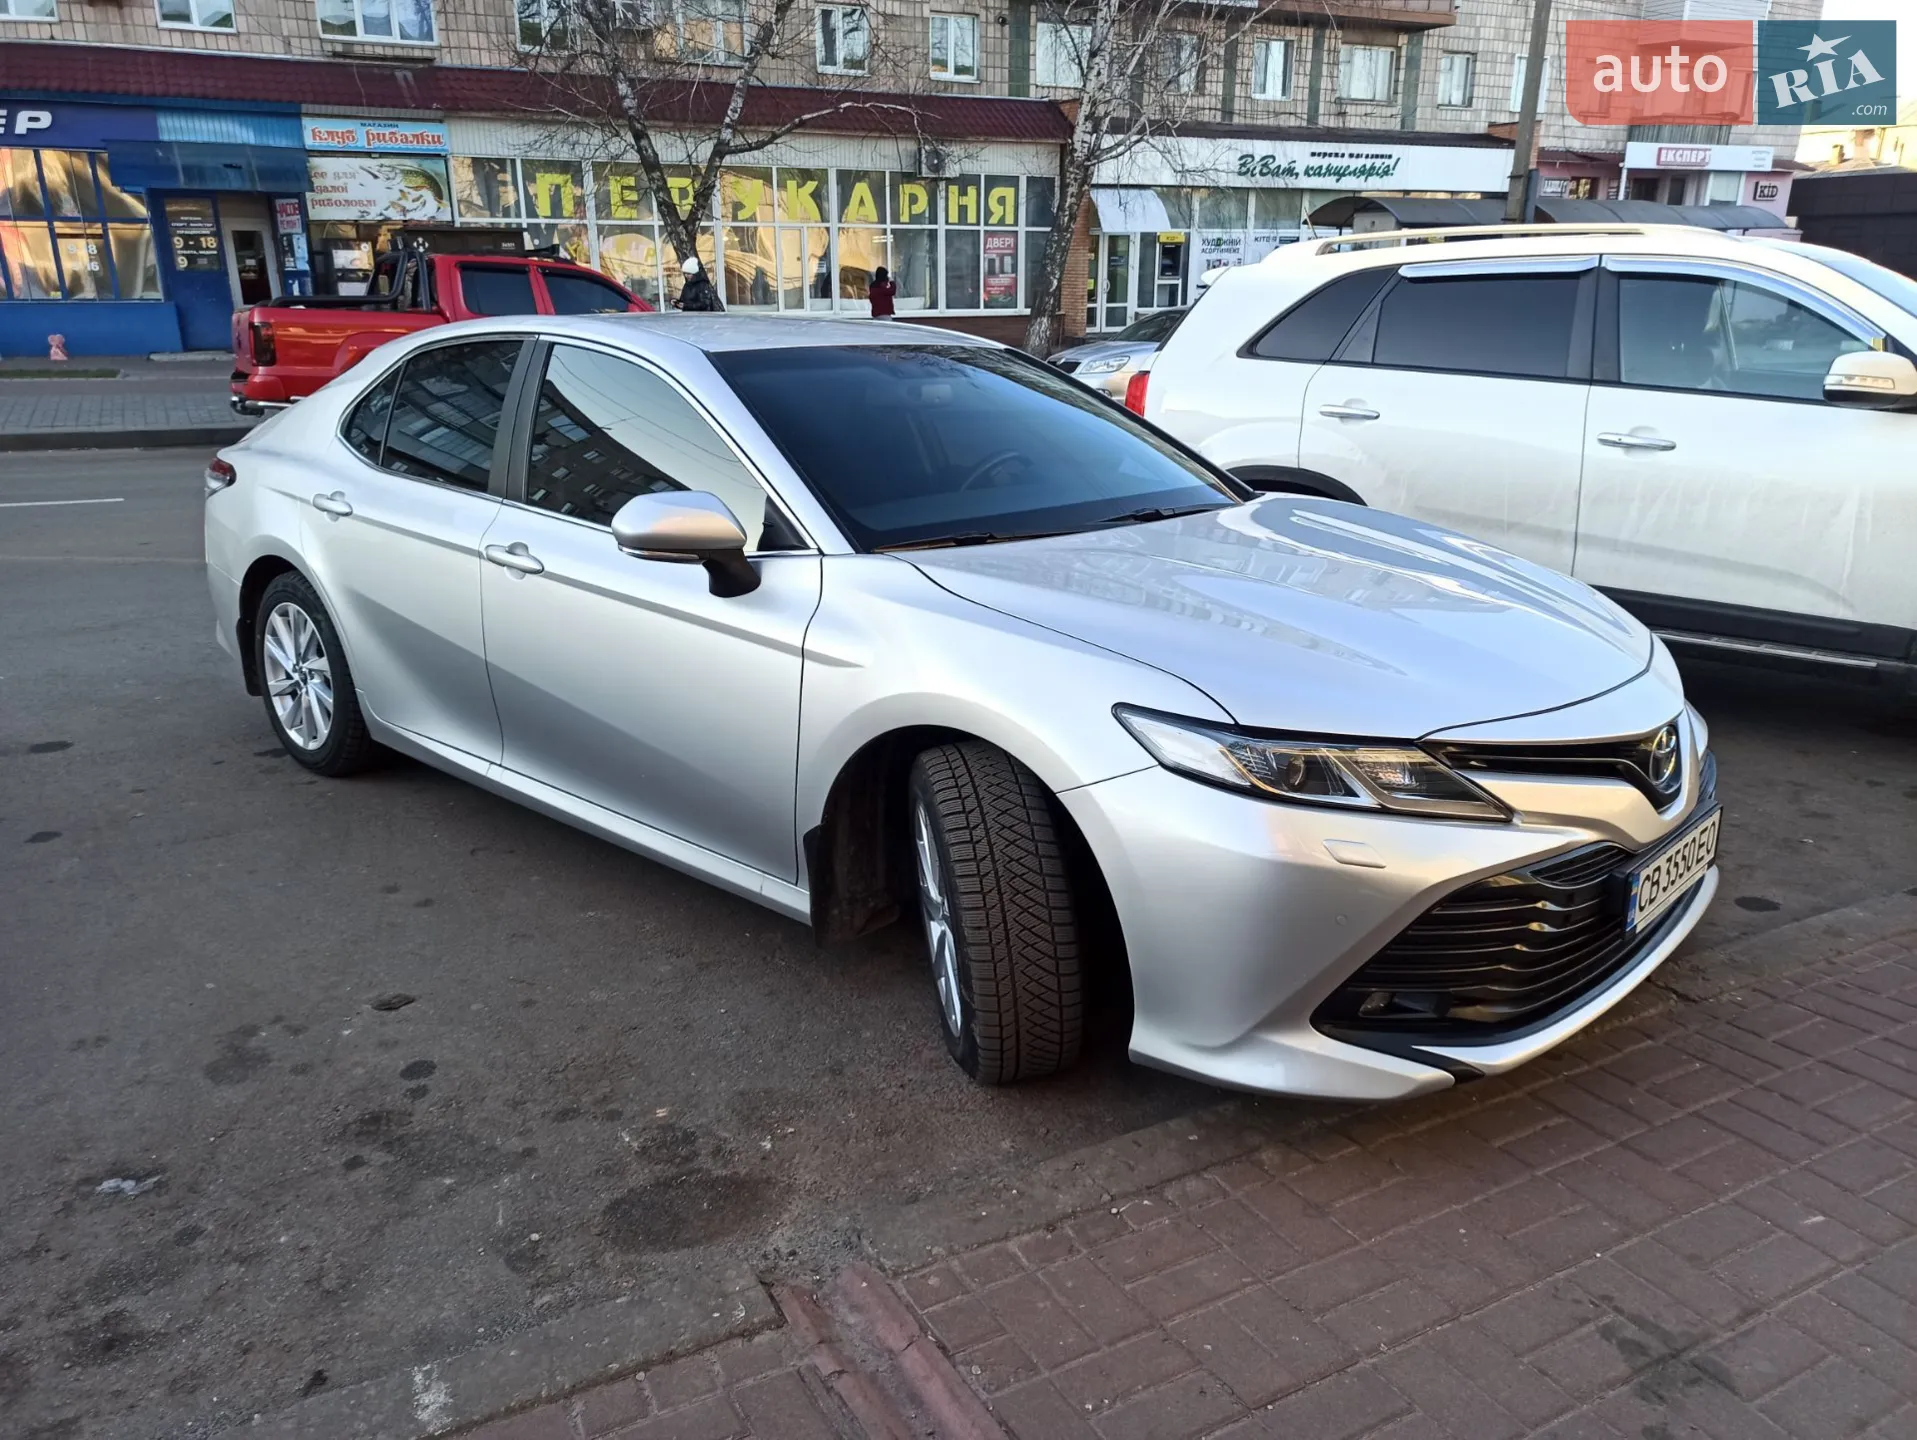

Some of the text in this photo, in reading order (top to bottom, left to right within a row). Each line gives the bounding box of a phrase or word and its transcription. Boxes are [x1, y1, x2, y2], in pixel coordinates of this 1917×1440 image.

[0, 109, 53, 135] Р
[1660, 149, 1710, 163] ЕКСПЕРТ
[173, 236, 184, 249] 9
[200, 236, 217, 249] 18
[1638, 820, 1717, 913] CB 3550 EO
